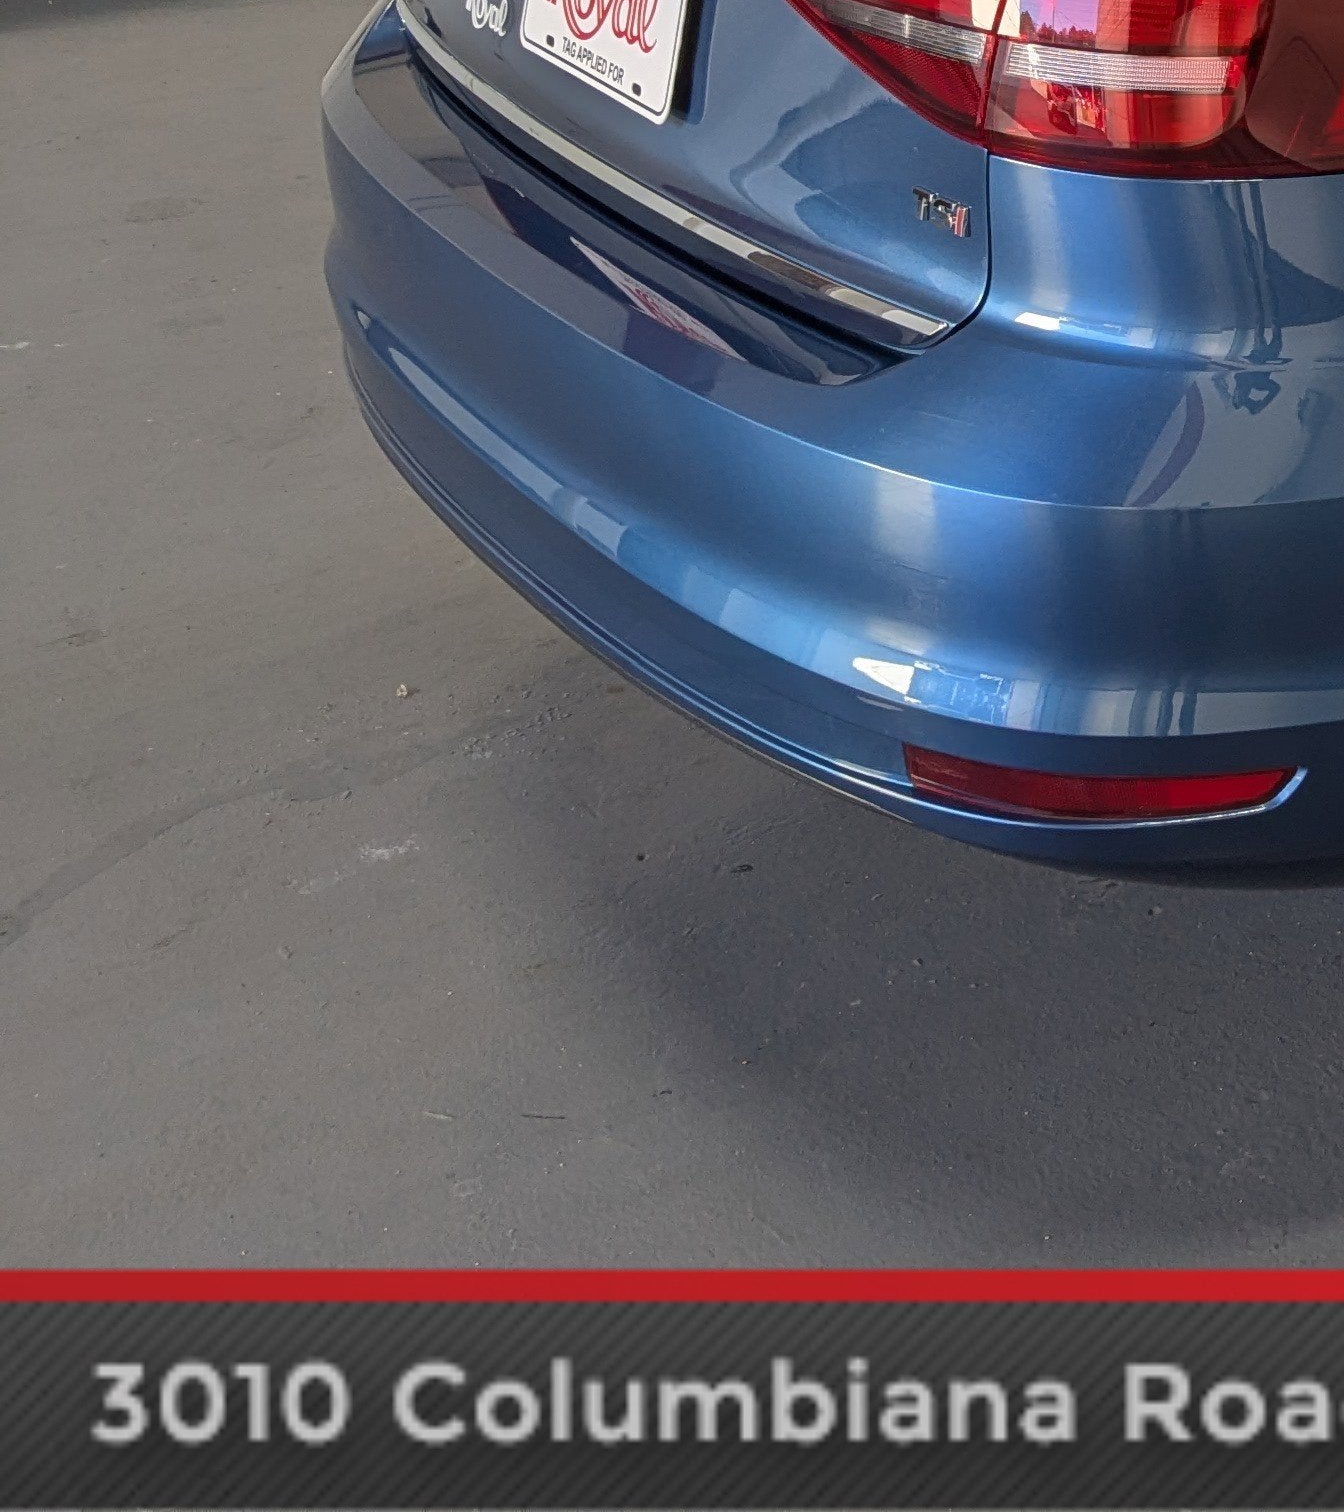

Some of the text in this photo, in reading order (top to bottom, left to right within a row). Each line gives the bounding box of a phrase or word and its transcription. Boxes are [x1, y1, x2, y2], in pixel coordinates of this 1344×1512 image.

[562, 36, 624, 86] TAG APPLIED FOR
